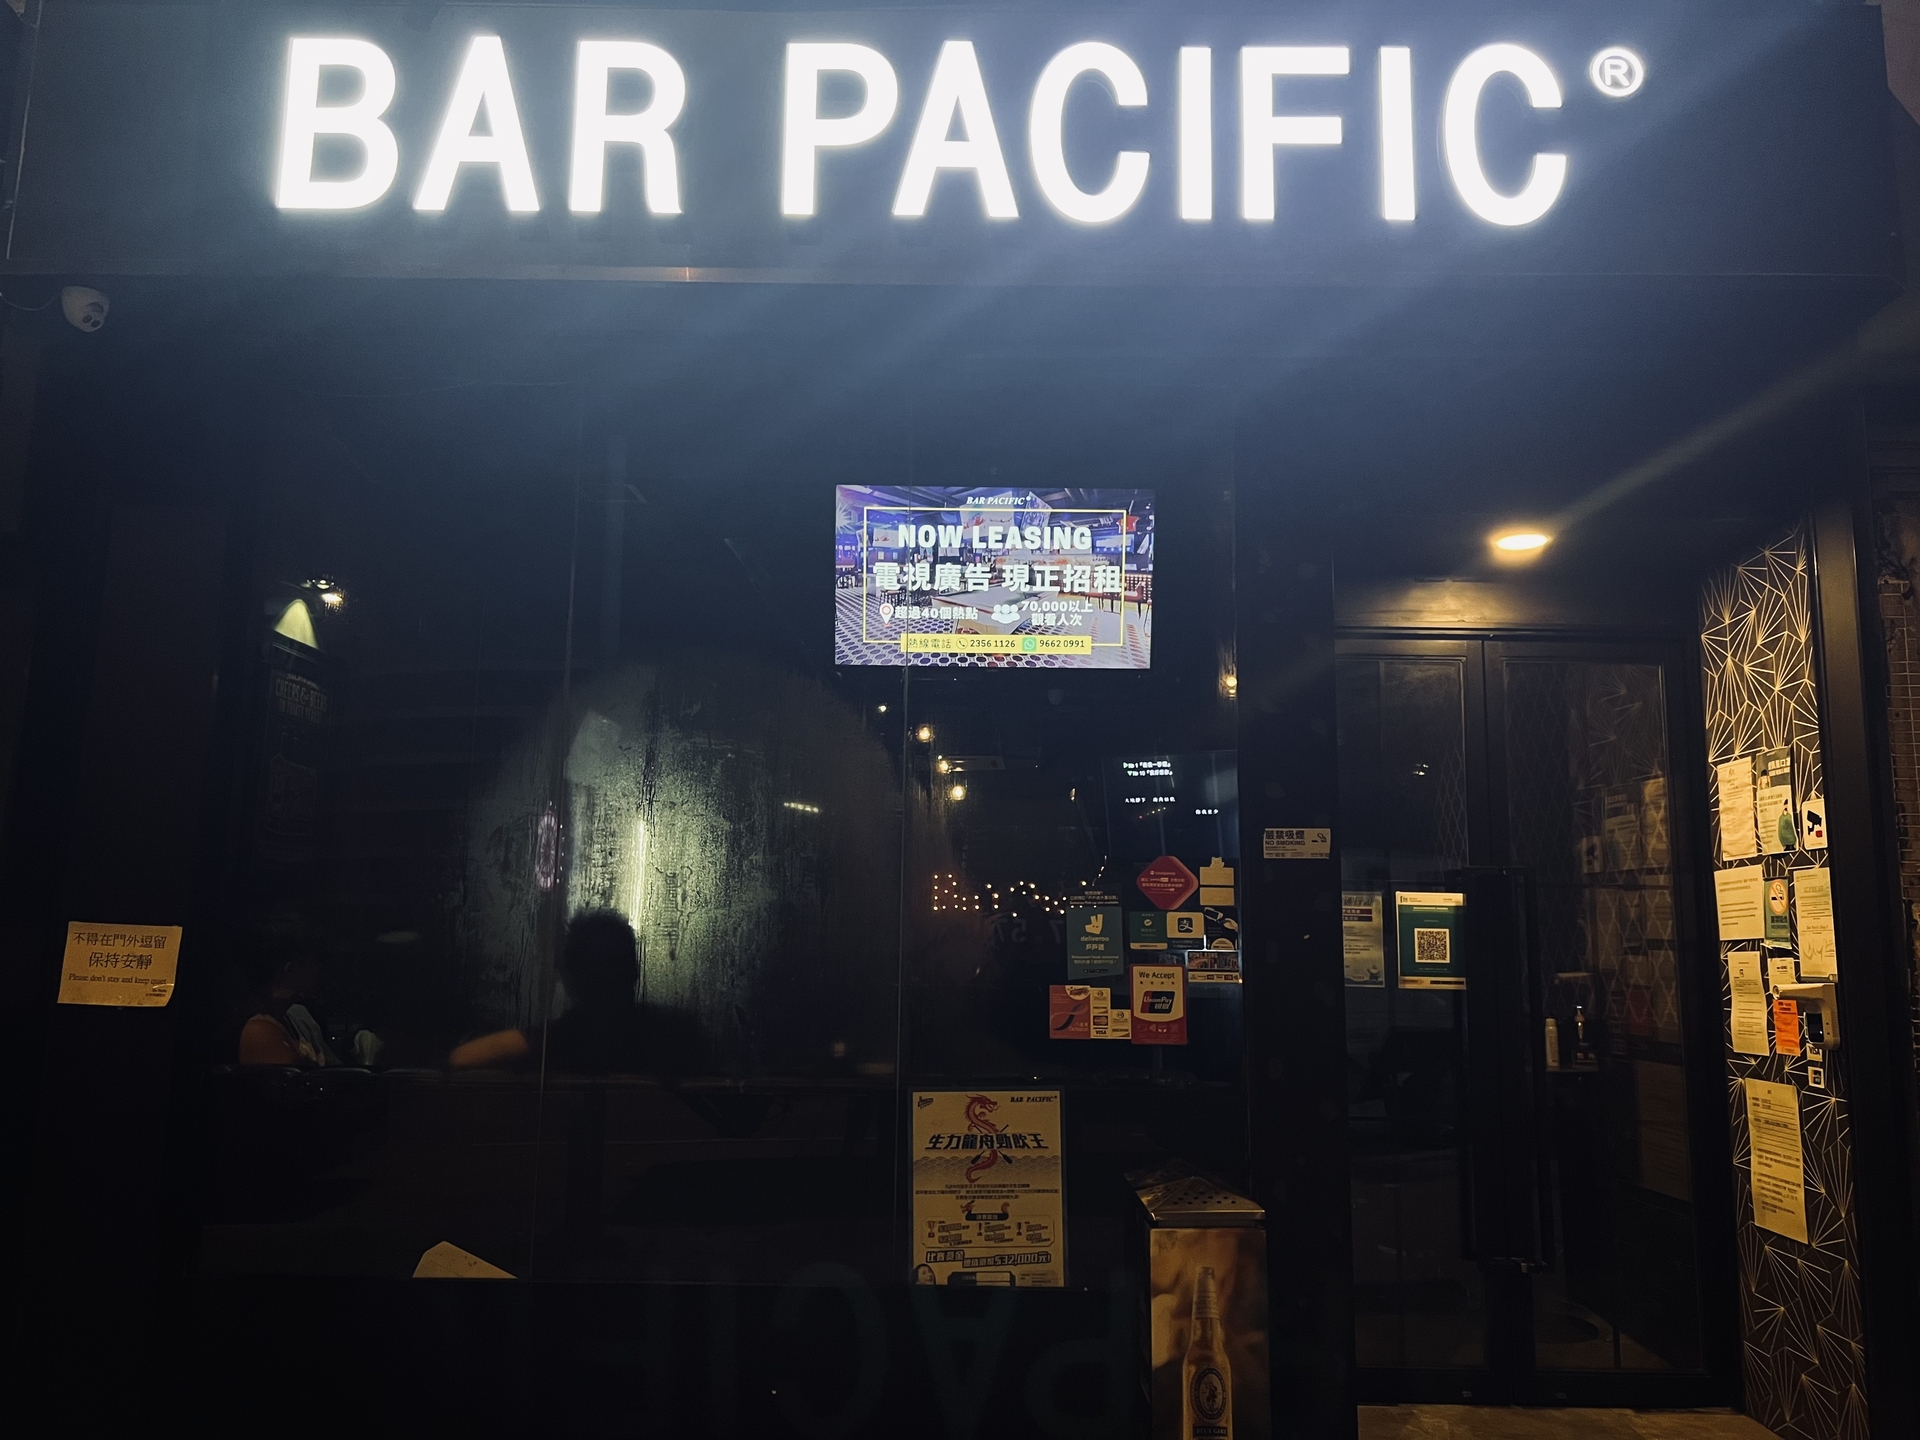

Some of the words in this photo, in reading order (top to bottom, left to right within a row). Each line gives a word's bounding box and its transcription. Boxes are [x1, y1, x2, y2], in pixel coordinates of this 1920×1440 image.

[275, 36, 685, 214] BAR
[782, 41, 1566, 226] PACIFIC
[966, 496, 986, 505] BAR
[986, 496, 1025, 506] PACIFIC
[898, 524, 964, 549] NOW
[972, 525, 1092, 550] LEASING
[872, 561, 992, 592] 電視廣告
[1001, 563, 1121, 594] 現正招租
[1020, 600, 1094, 613] 70,000以上
[969, 638, 992, 649] 2356
[994, 639, 1016, 649] 1126
[1039, 639, 1061, 649] 9662
[1063, 639, 1085, 649] 0991
[73, 931, 167, 949] 不得在門外逗留
[88, 951, 153, 970] 保持安靜
[68, 973, 89, 982] Please
[1139, 971, 1150, 979] We
[1151, 971, 1175, 980] Accept
